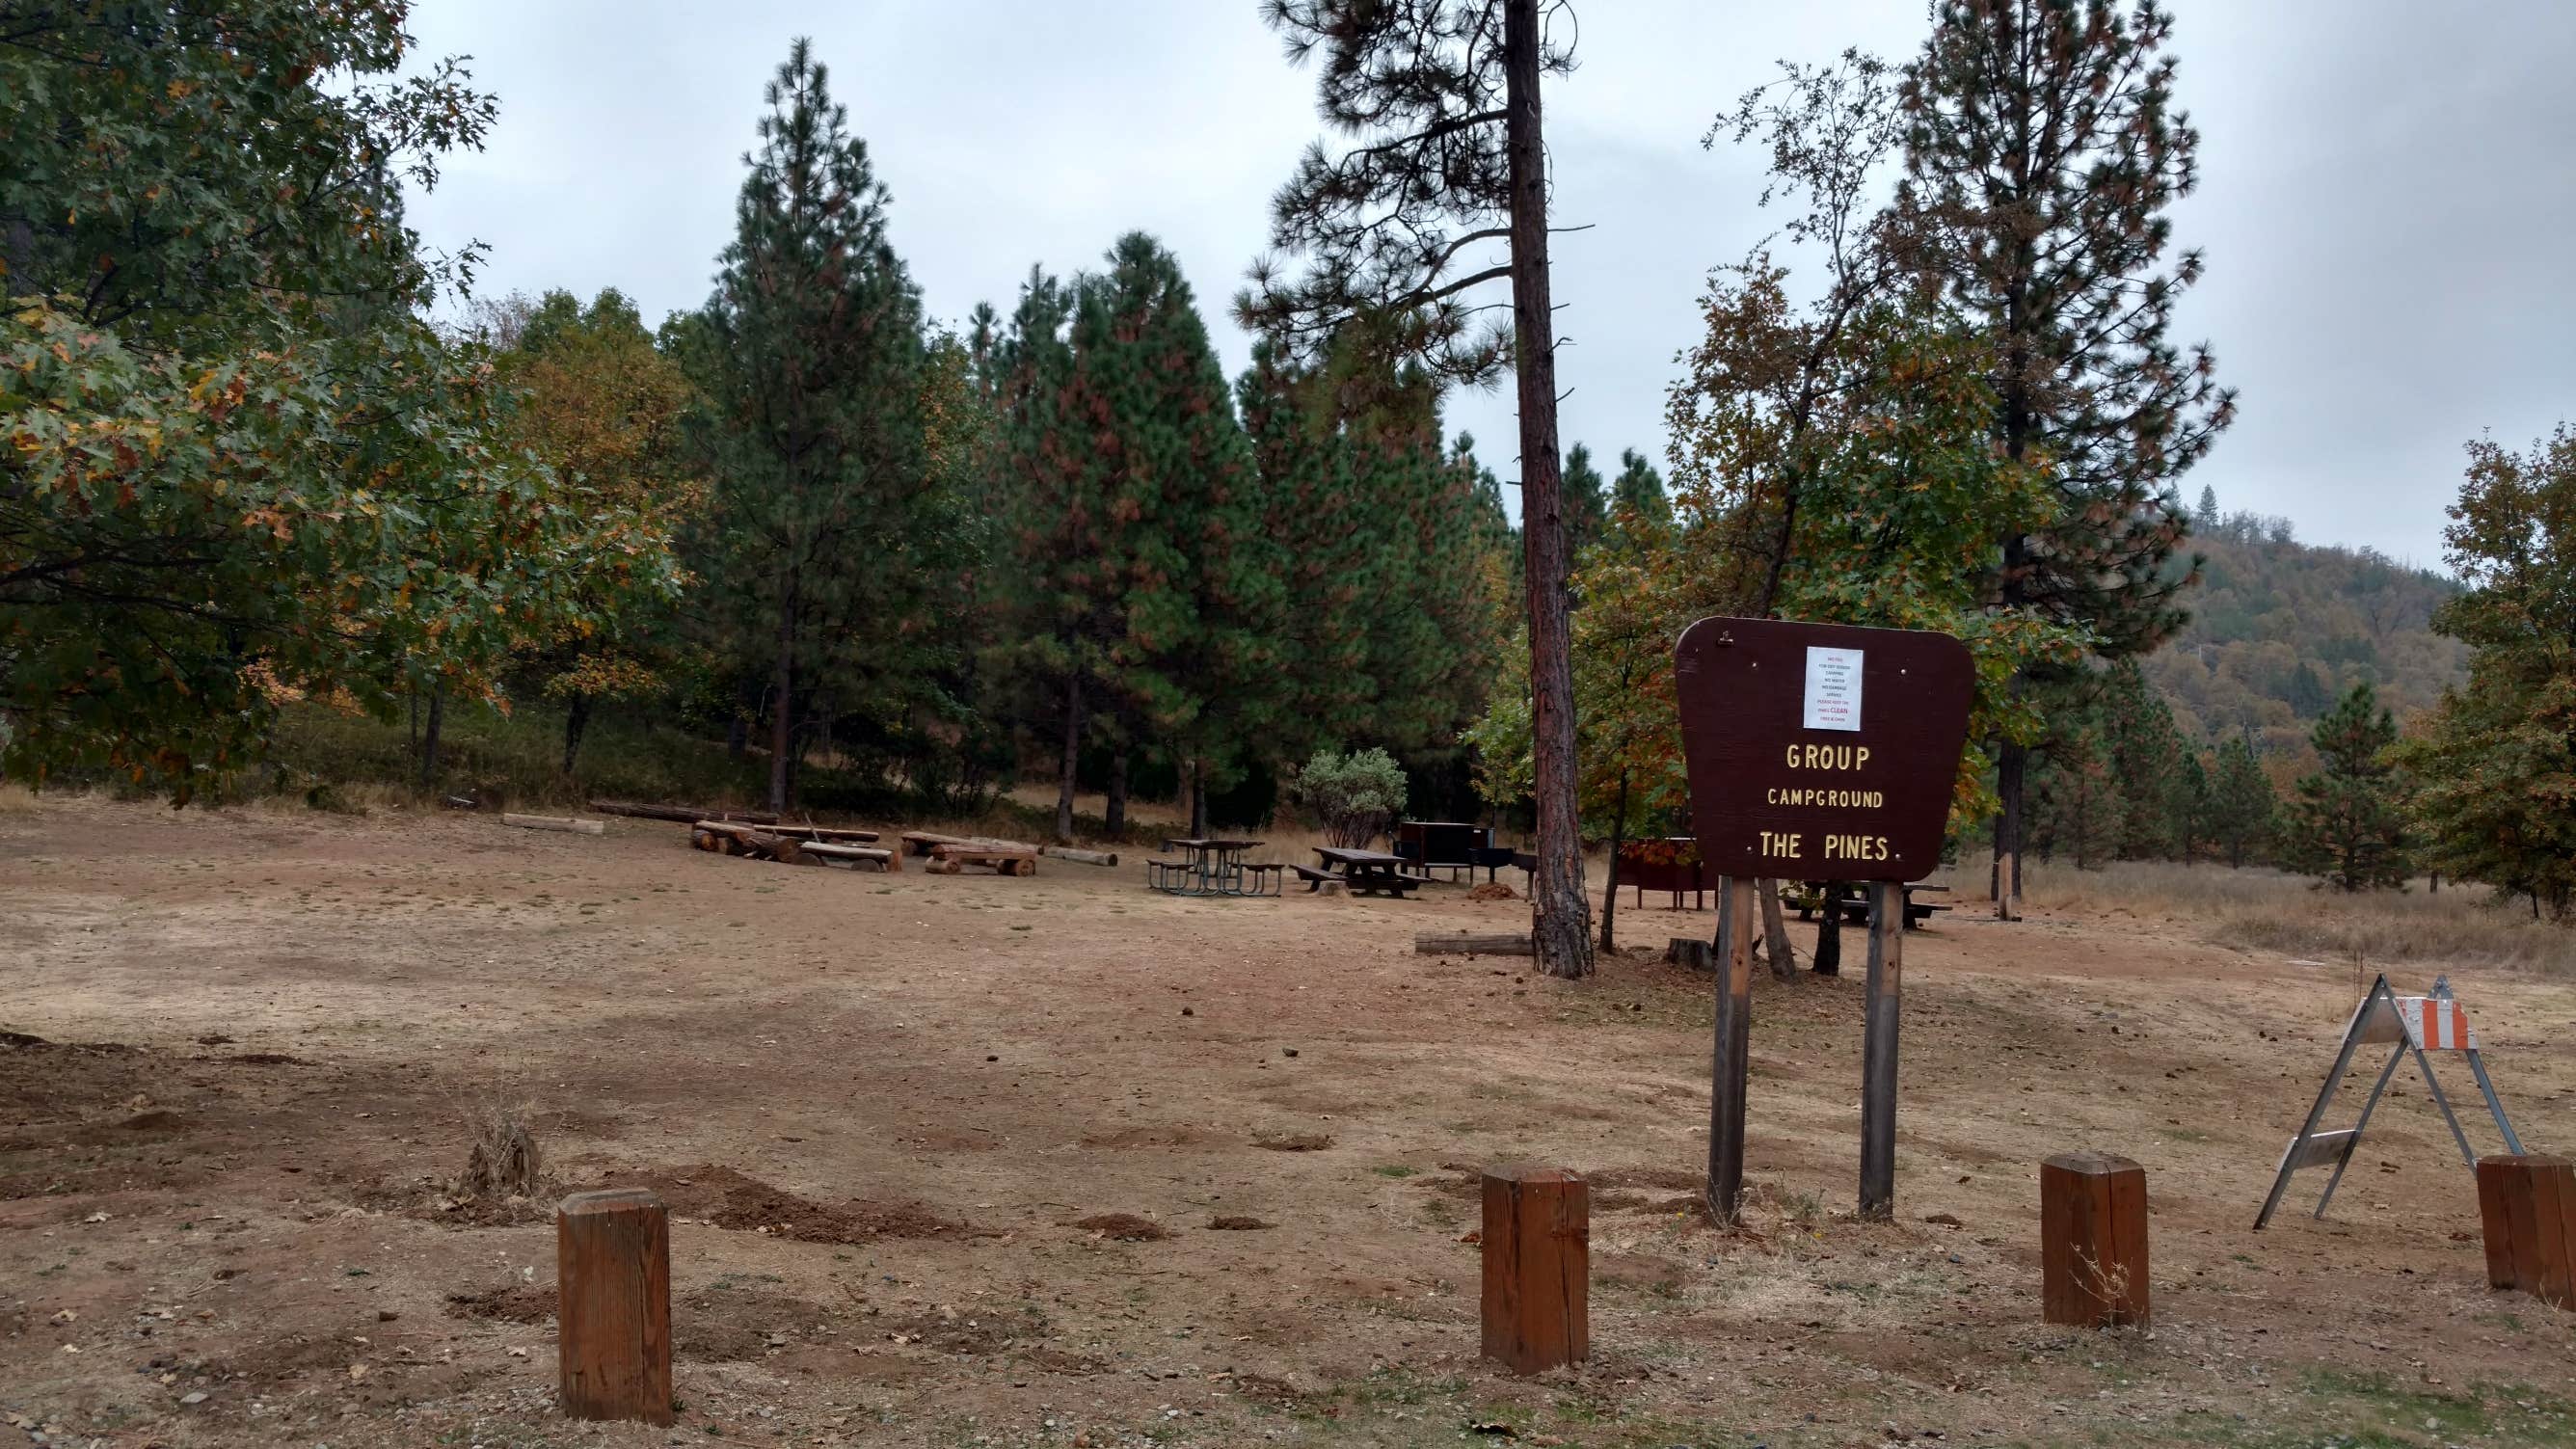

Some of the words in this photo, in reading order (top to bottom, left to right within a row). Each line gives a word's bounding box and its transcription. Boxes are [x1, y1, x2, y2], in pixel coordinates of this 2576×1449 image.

[1786, 743, 1870, 771] GROUP
[1767, 788, 1883, 808] CAMPGROUND
[1759, 831, 1802, 859] THE
[1825, 834, 1889, 861] PINES
